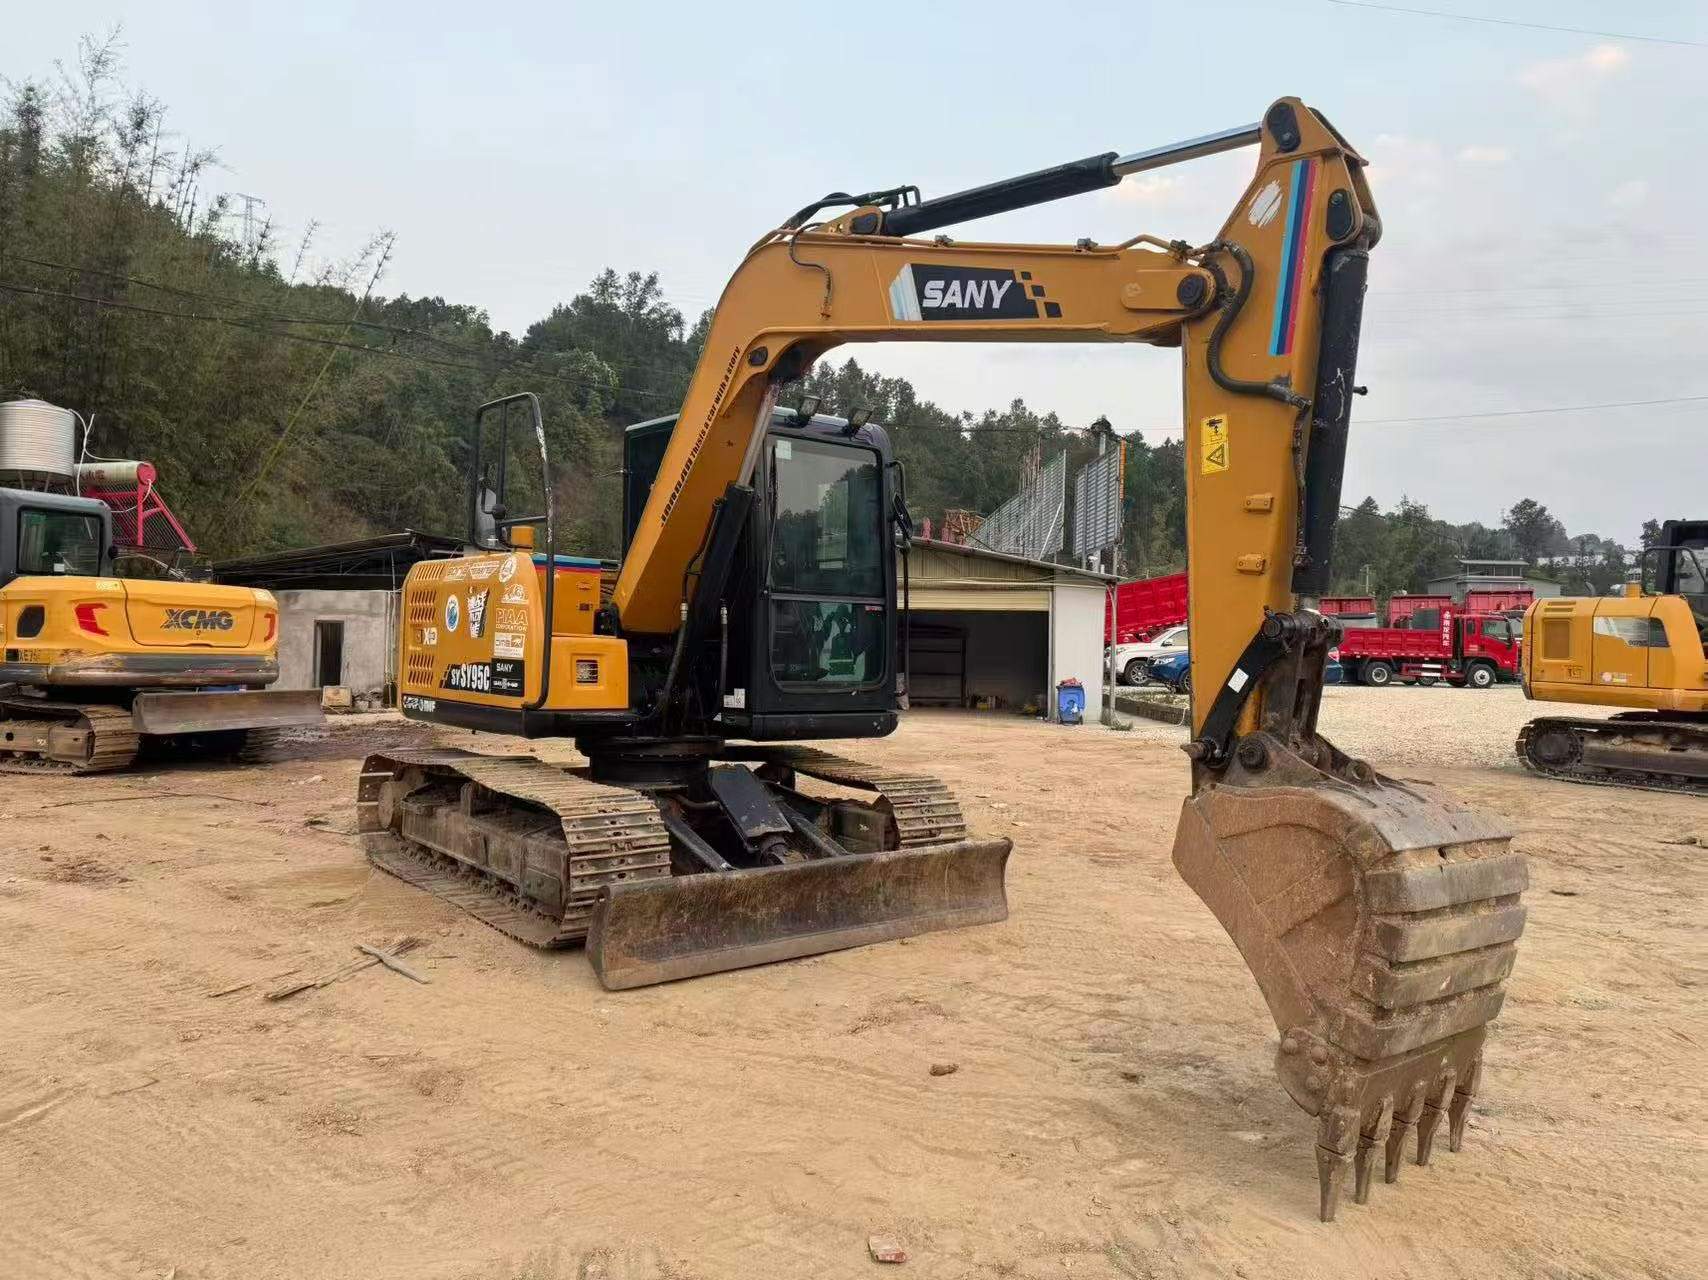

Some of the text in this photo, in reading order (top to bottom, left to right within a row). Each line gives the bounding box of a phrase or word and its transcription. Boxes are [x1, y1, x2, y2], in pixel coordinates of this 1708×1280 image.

[922, 279, 1013, 309] SANY
[714, 382, 727, 404] with
[727, 346, 741, 374] story
[160, 608, 234, 630] XCMG
[496, 607, 529, 625] PIAA
[496, 662, 514, 673] SANY
